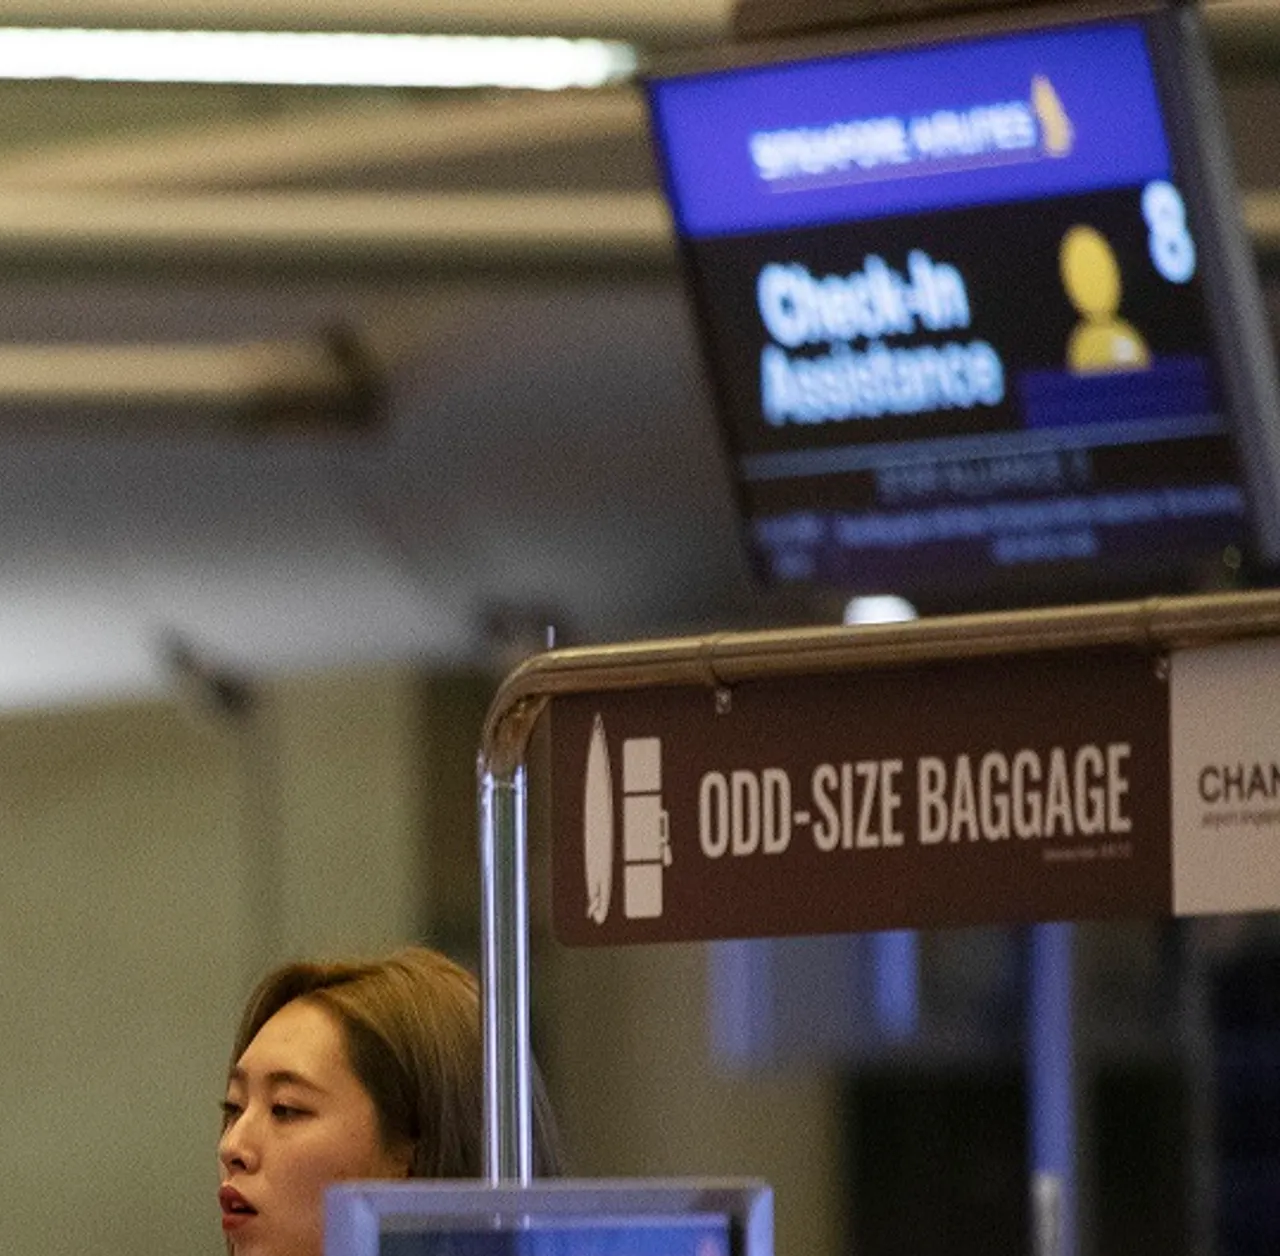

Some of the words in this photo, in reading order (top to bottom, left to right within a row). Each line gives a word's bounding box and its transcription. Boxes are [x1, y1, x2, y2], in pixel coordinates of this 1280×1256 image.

[1142, 180, 1195, 283] 8
[757, 250, 971, 348] Check-In
[760, 340, 1006, 426] Assistance
[698, 758, 904, 858] ODD-SIZE
[917, 742, 1133, 845] BAGGAGE
